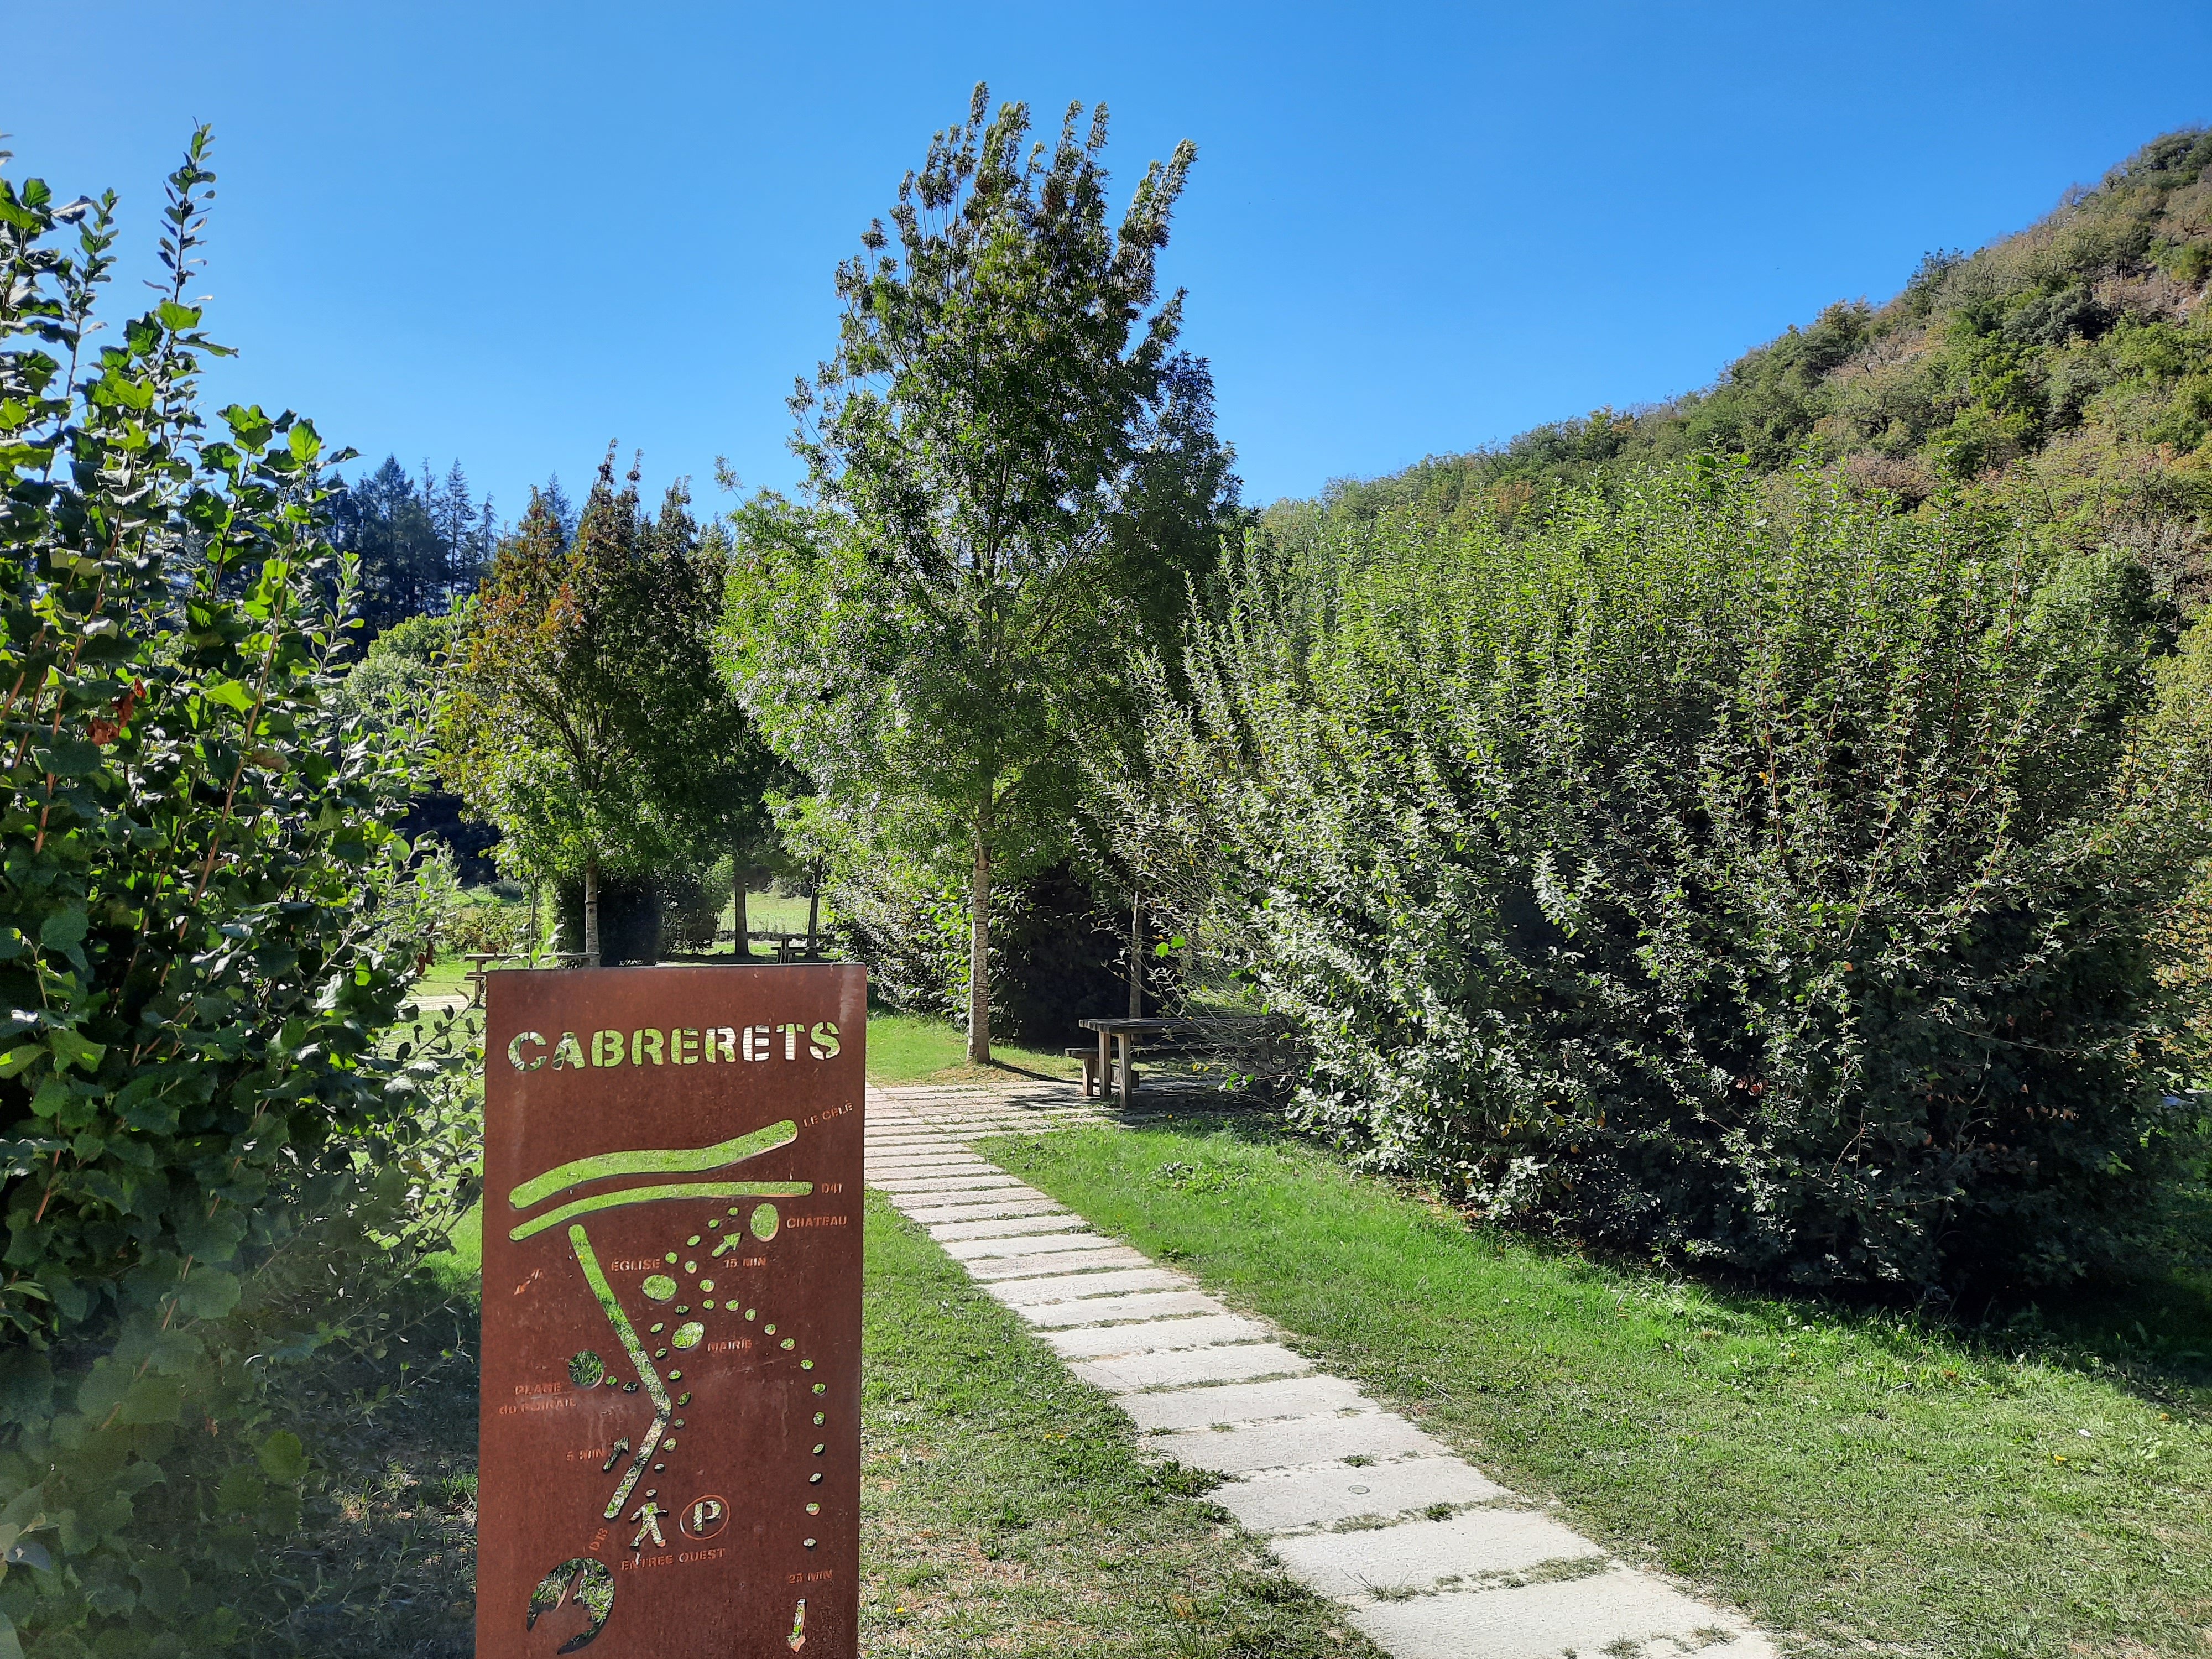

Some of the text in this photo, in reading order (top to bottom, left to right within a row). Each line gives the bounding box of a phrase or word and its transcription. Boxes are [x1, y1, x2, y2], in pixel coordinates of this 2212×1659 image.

[508, 1021, 841, 1071] CABRERETS
[803, 1114, 818, 1128] LE
[611, 1258, 661, 1272] ÉGLISE
[723, 1256, 767, 1269] 15 MIN
[707, 1338, 753, 1352] MAIRIE
[499, 1405, 517, 1415] du
[579, 1448, 604, 1460] MIN
[693, 1500, 721, 1531] P
[589, 1527, 608, 1551] D13
[621, 1548, 726, 1571] ENTRÉE OUEST
[789, 1569, 832, 1584] 25 MIN
